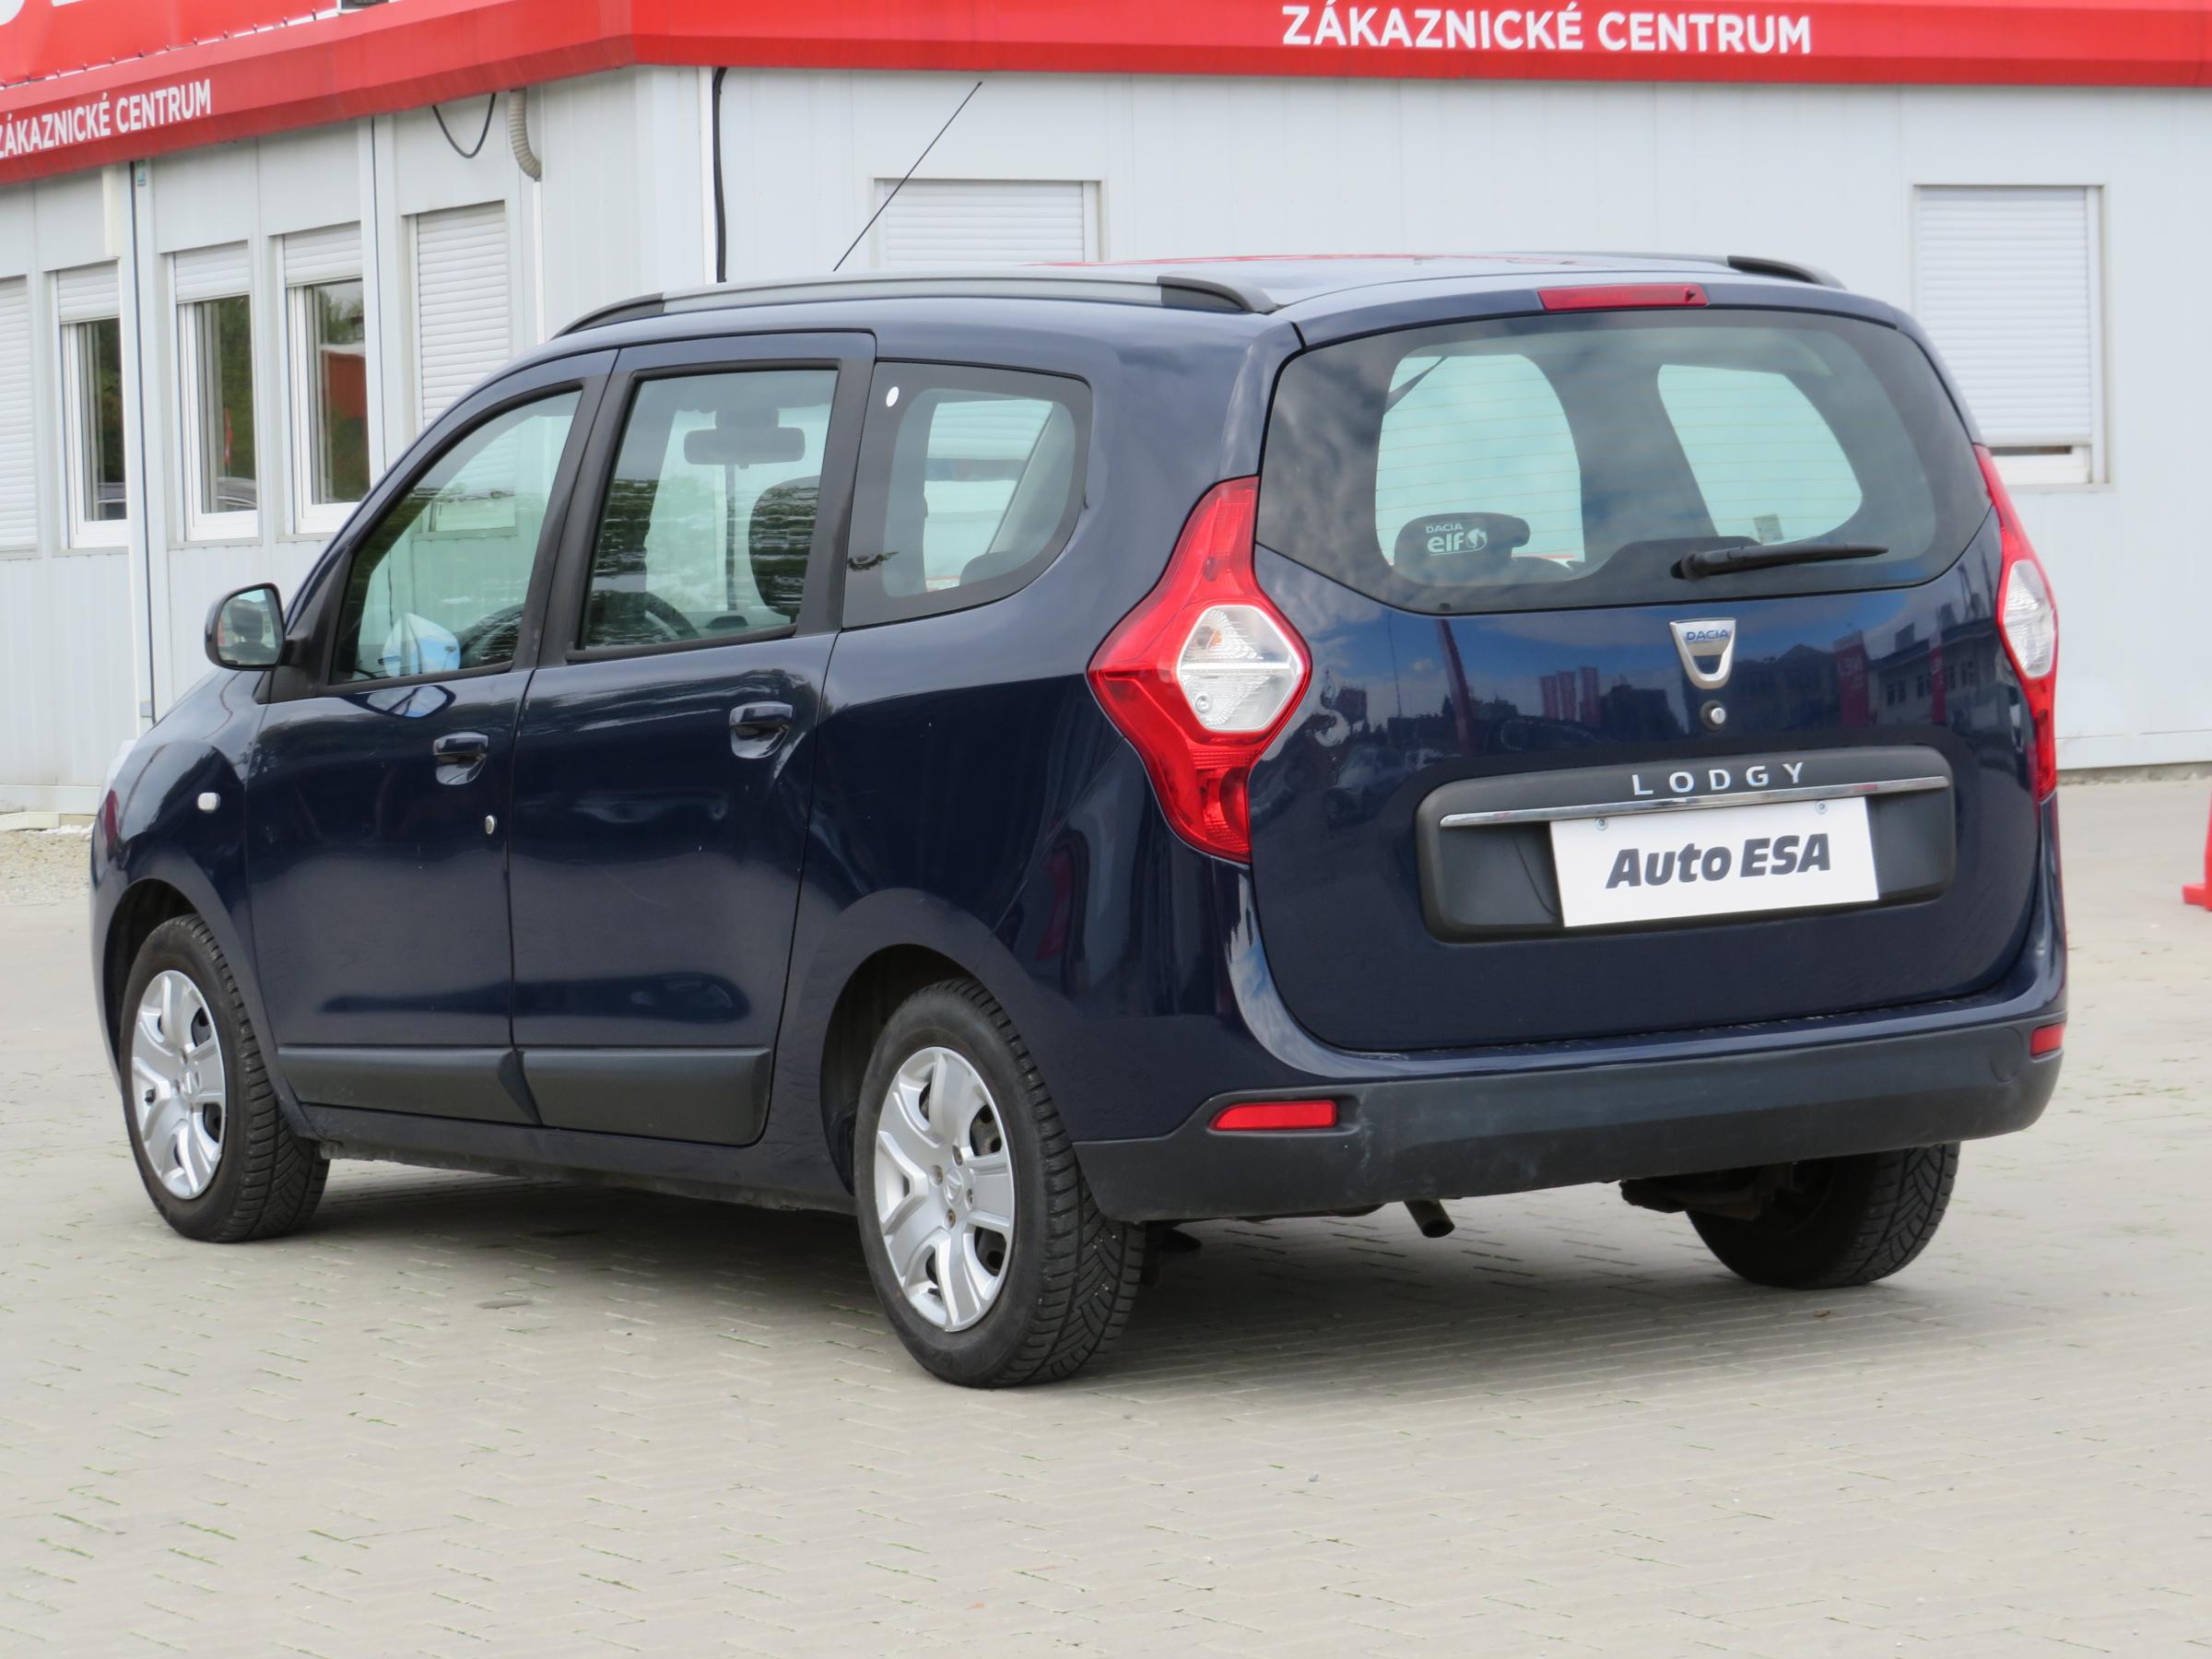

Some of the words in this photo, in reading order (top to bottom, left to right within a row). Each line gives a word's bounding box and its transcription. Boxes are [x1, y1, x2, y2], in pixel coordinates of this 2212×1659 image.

[1281, 0, 1583, 51] ZÁKAZNICKÉ
[1597, 12, 1812, 54] CENTRUM
[115, 78, 212, 134] CENTRUM
[1426, 523, 1464, 533] DACIA
[1428, 533, 1465, 553] elf
[1686, 629, 1731, 642] DACIA
[1630, 761, 1805, 796] LODGY
[1605, 842, 1733, 889] Auto
[1739, 832, 1831, 878] ESA
